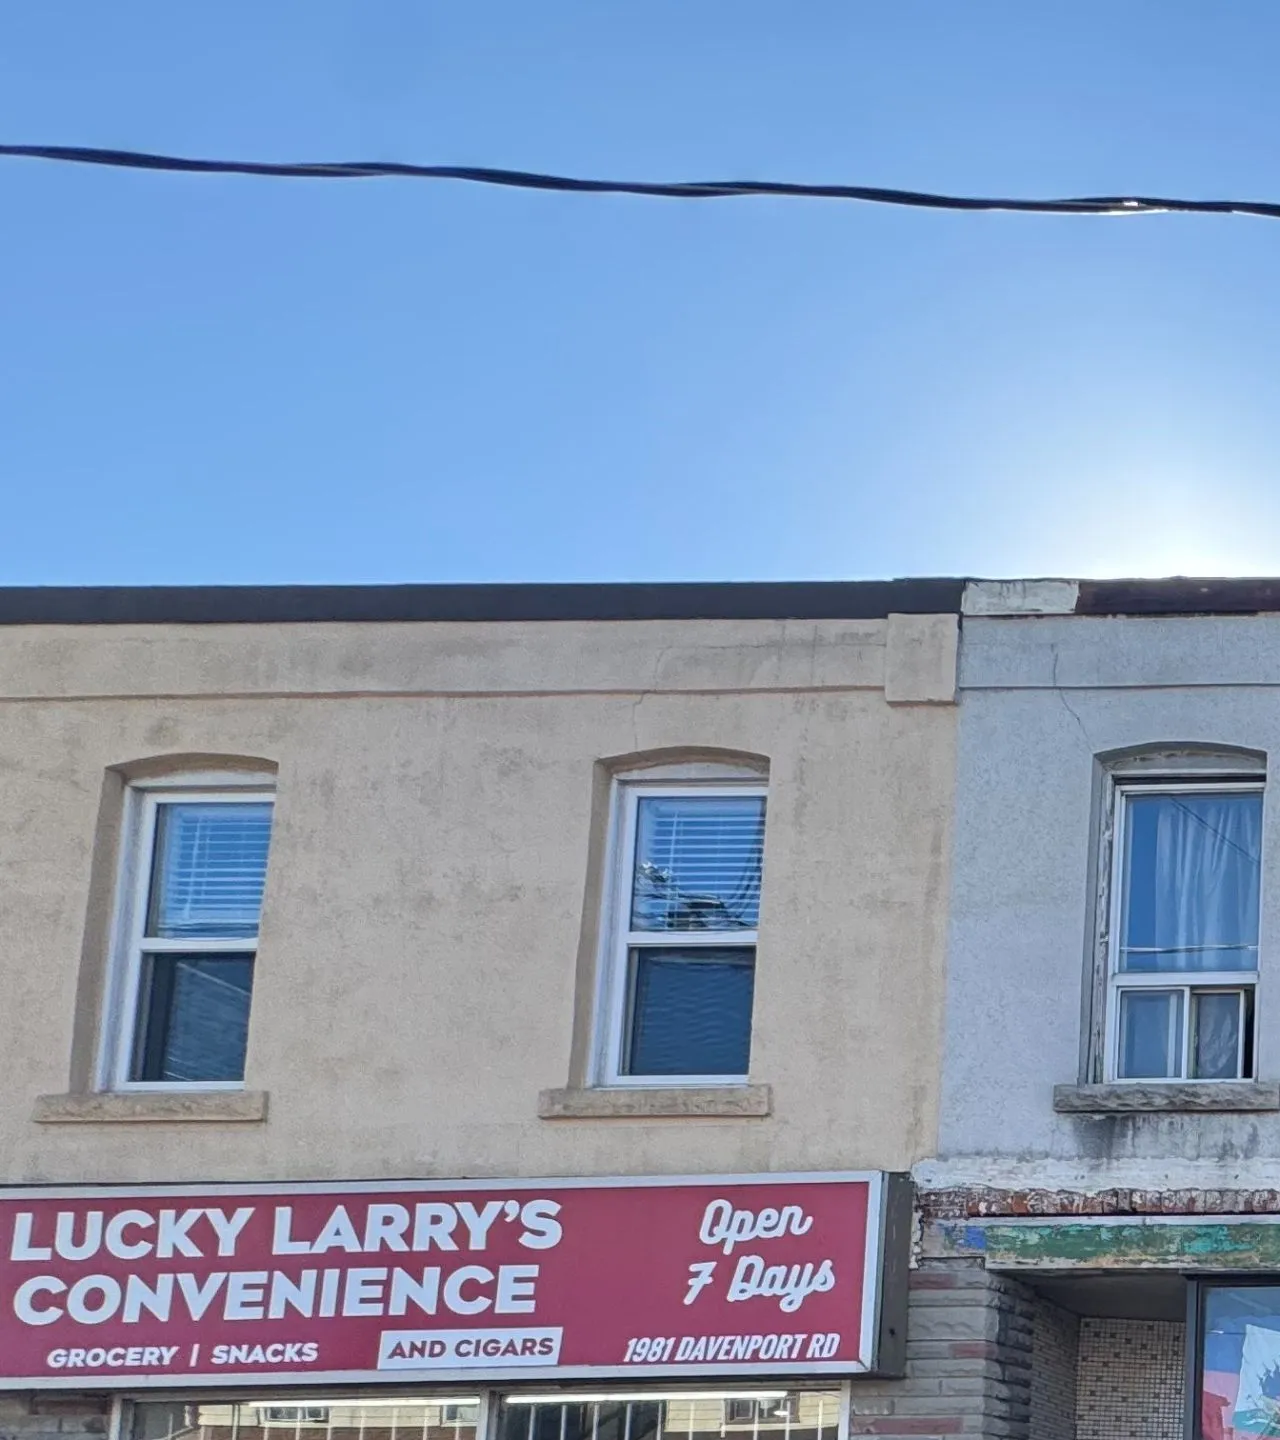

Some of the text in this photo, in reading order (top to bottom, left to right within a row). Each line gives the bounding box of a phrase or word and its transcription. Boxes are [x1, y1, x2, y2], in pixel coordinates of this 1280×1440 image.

[10, 1199, 564, 1261] LUCKY LARRY'S
[699, 1199, 813, 1249] Open
[13, 1265, 540, 1326] CONVENIENCE
[683, 1255, 836, 1313] 7 Days
[46, 1341, 319, 1368] GROCERY SNACKS
[387, 1335, 555, 1361] AND CIGARS
[623, 1333, 841, 1363] 1981 DAVENPORT RD
